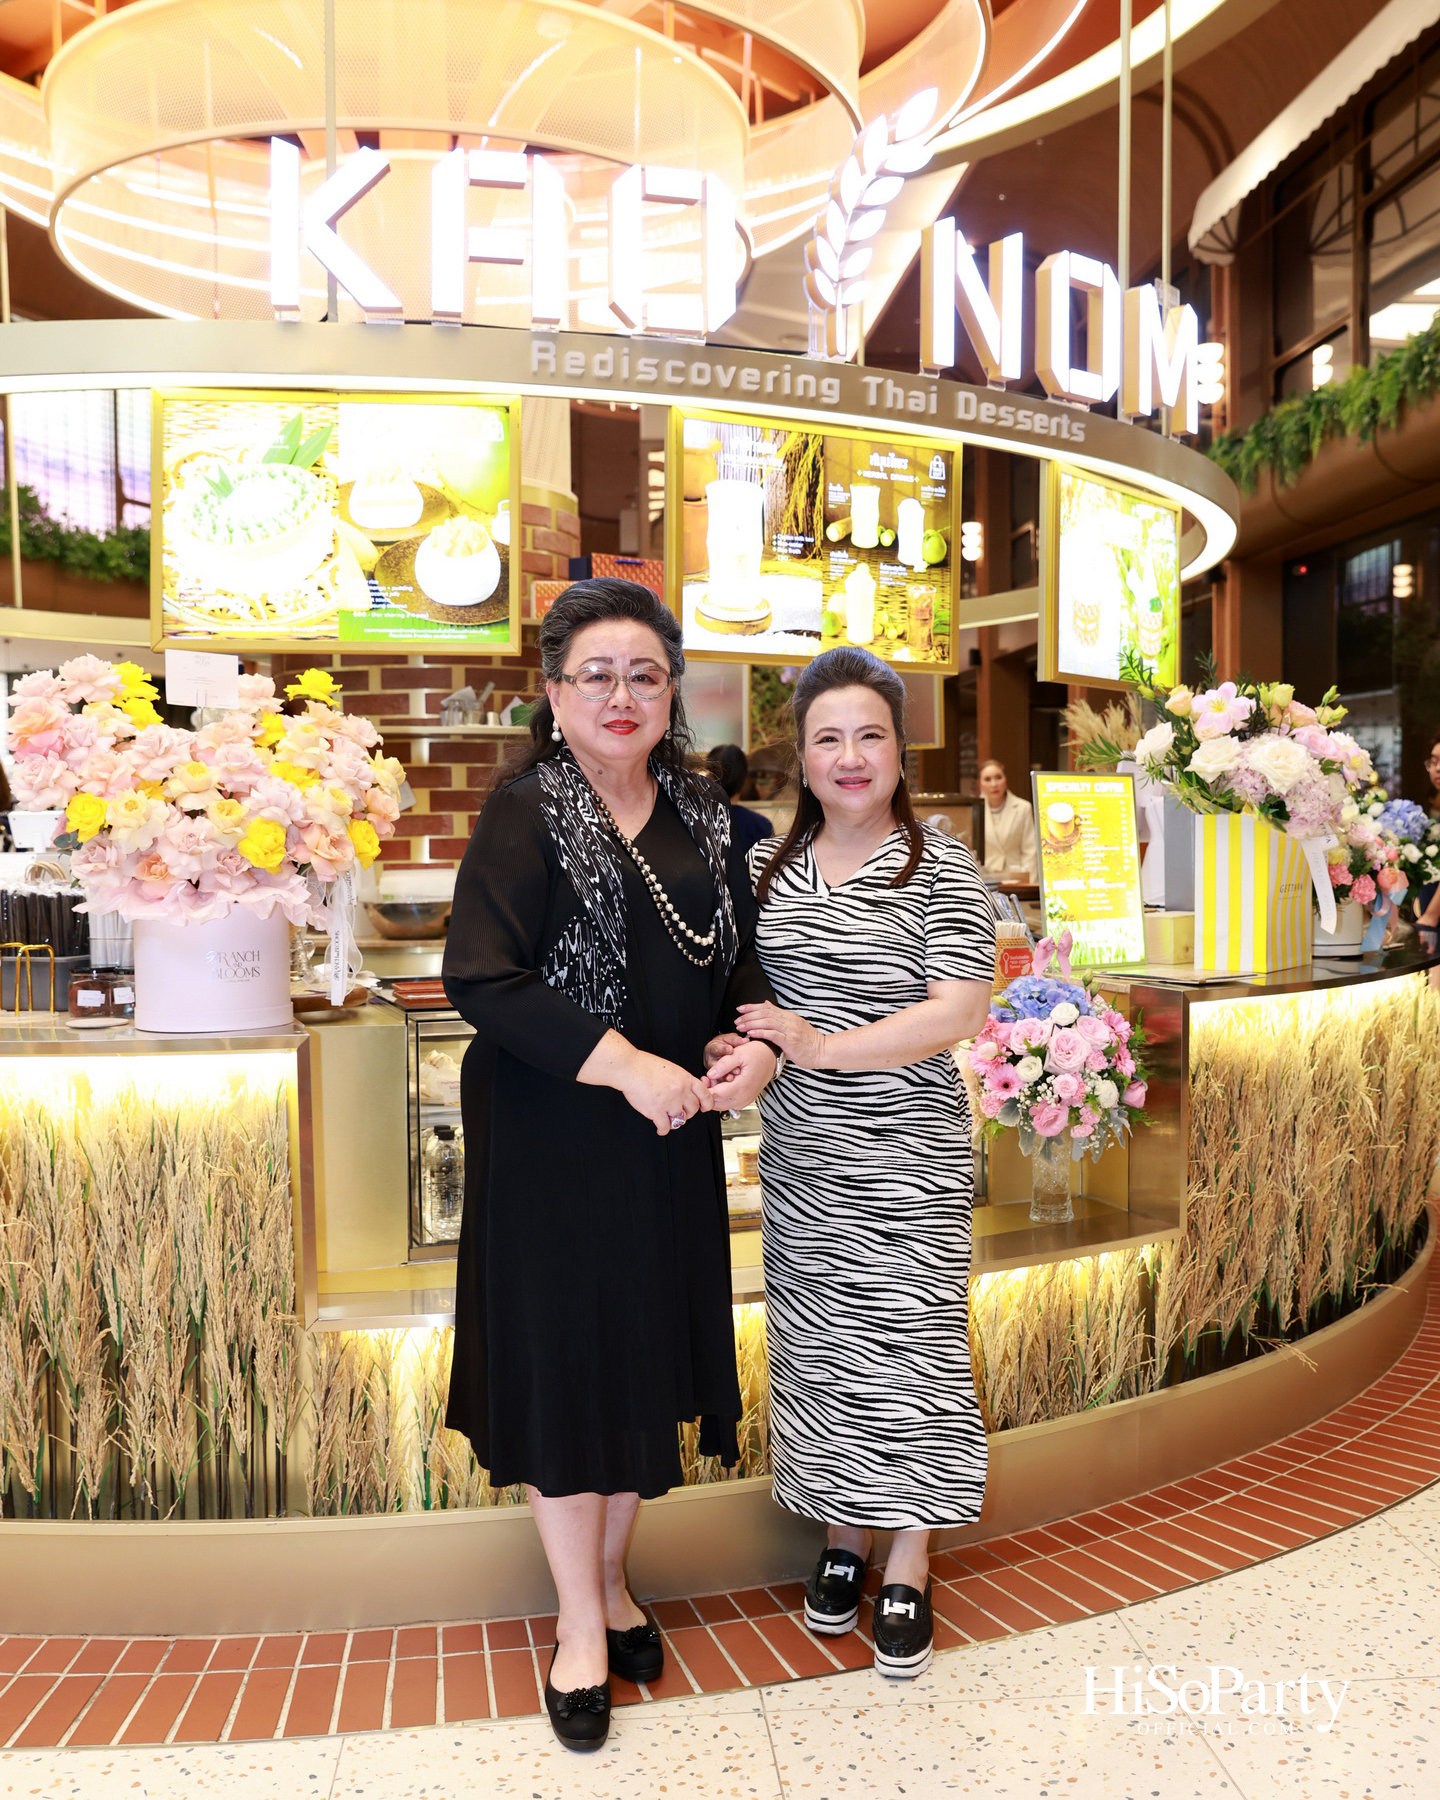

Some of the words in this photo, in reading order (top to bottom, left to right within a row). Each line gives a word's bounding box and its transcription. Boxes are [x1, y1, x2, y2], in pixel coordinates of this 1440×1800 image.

[271, 136, 736, 334] KAO
[920, 216, 1199, 435] NOM
[530, 340, 841, 404] Rediscovering
[862, 375, 938, 414] Thai
[957, 390, 1087, 443] Desserts
